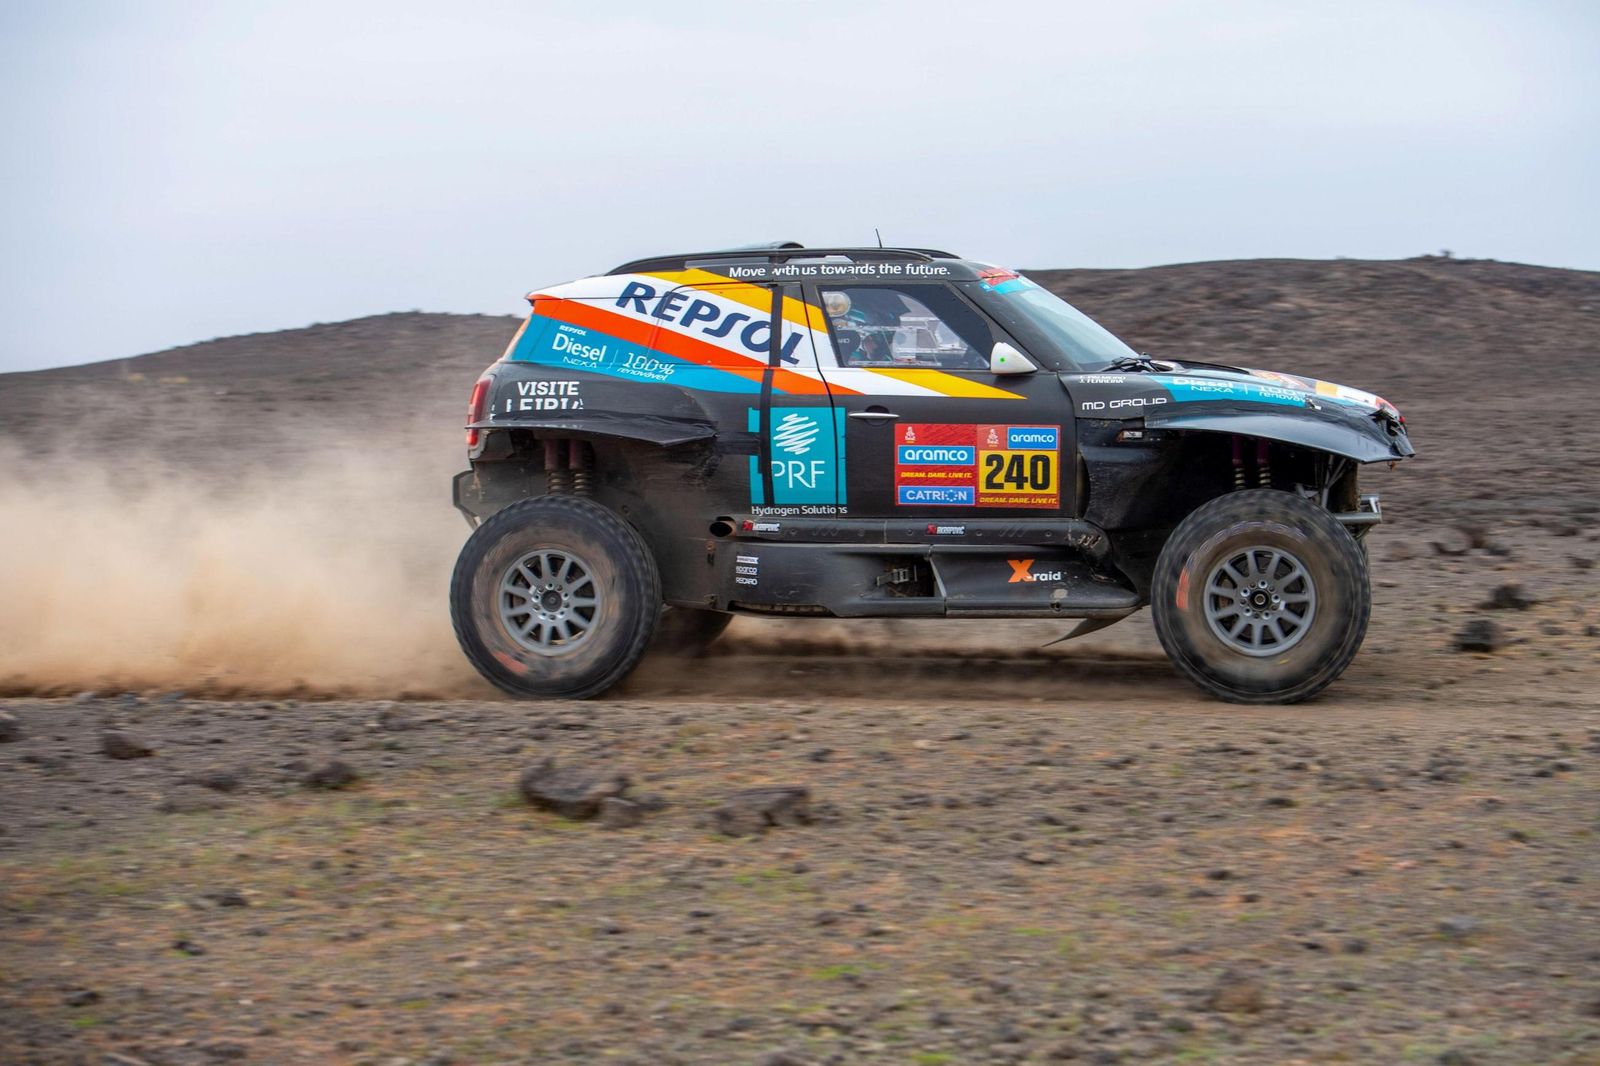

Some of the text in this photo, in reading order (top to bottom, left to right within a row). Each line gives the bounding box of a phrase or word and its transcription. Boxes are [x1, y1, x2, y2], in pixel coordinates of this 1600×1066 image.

[729, 267, 766, 278] Move
[802, 265, 817, 275] us
[821, 264, 875, 275] towards
[879, 264, 902, 275] the
[906, 264, 951, 276] future.
[615, 281, 803, 365] REPSOL
[552, 333, 607, 362] Diesel
[563, 356, 598, 369] NEXA
[623, 352, 675, 375] 100%
[517, 381, 580, 396] VISITE
[1190, 385, 1234, 394] NEXA
[1082, 401, 1105, 411] MD
[1010, 434, 1055, 443] aramco
[904, 449, 968, 461] aramco
[771, 460, 825, 489] PRF
[985, 454, 1050, 490] 240
[906, 490, 967, 502] CATRION
[751, 506, 800, 516] Hydrogen
